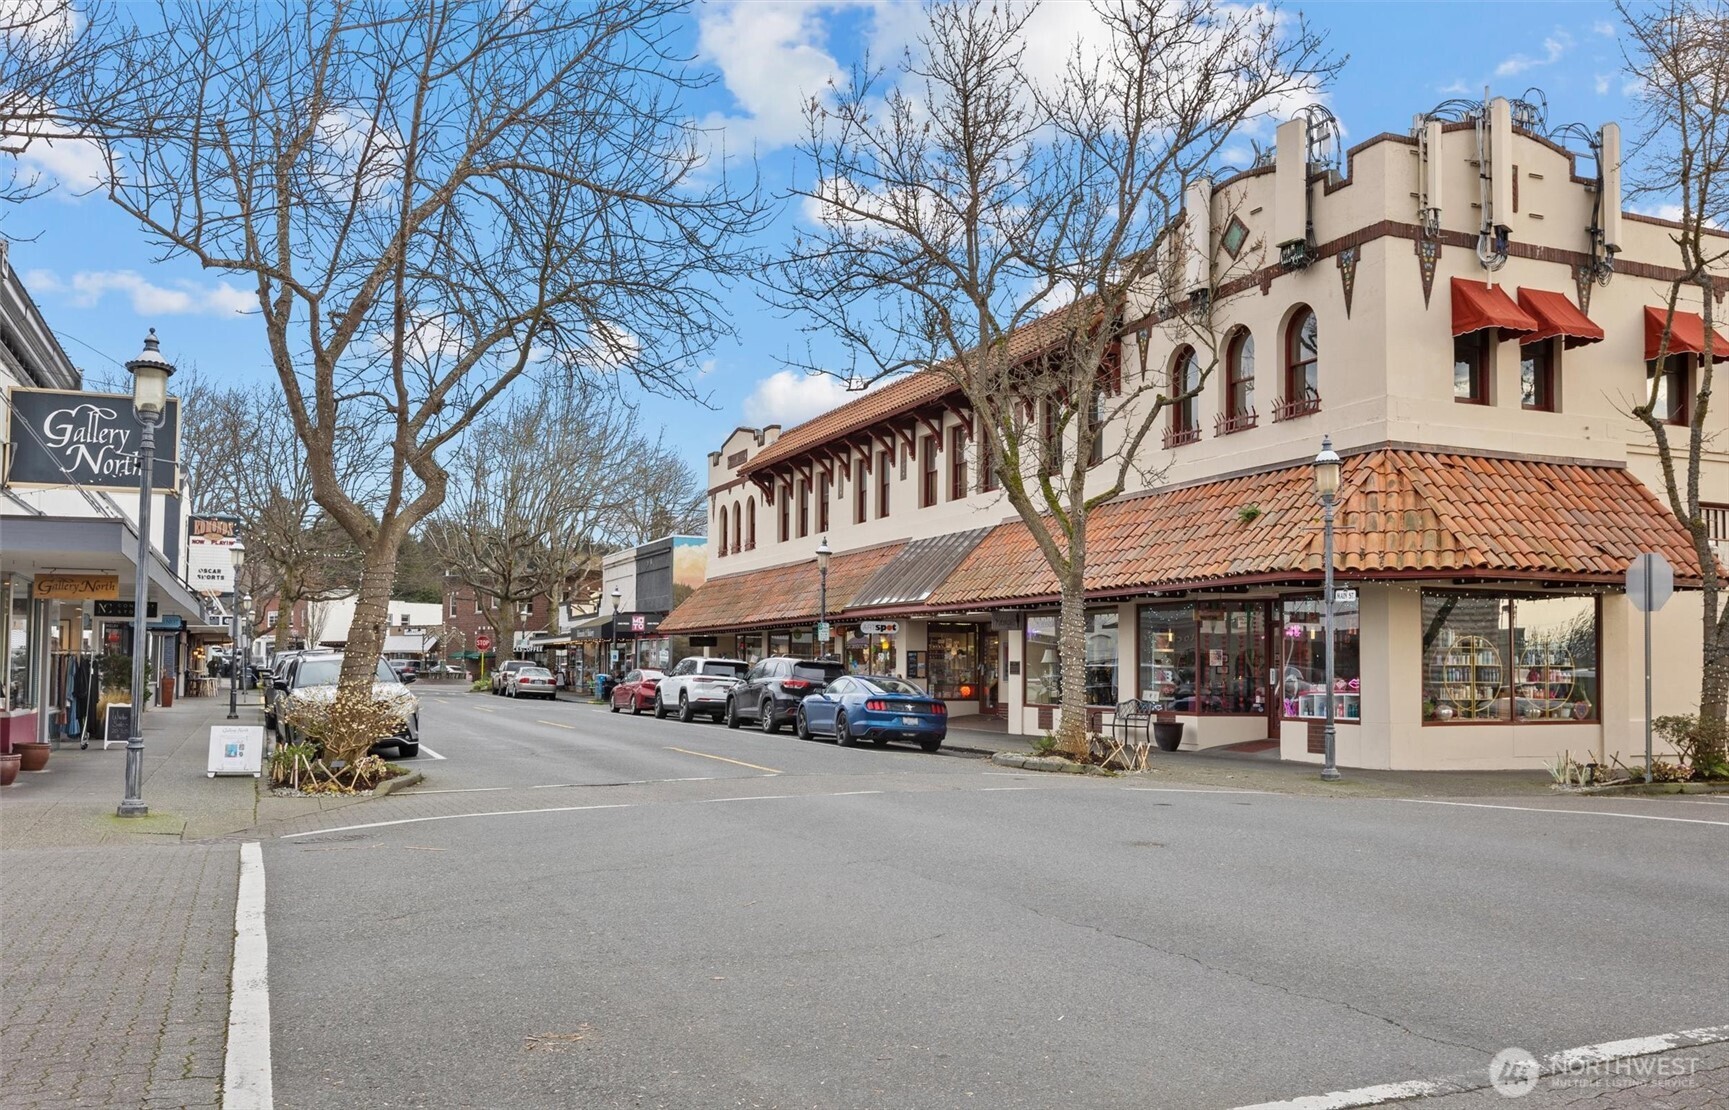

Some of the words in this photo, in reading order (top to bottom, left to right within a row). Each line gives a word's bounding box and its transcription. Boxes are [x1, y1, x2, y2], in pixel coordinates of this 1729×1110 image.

[44, 404, 131, 453] Gallery
[61, 443, 141, 476] North
[37, 577, 80, 595] Gallery
[80, 581, 116, 592] North
